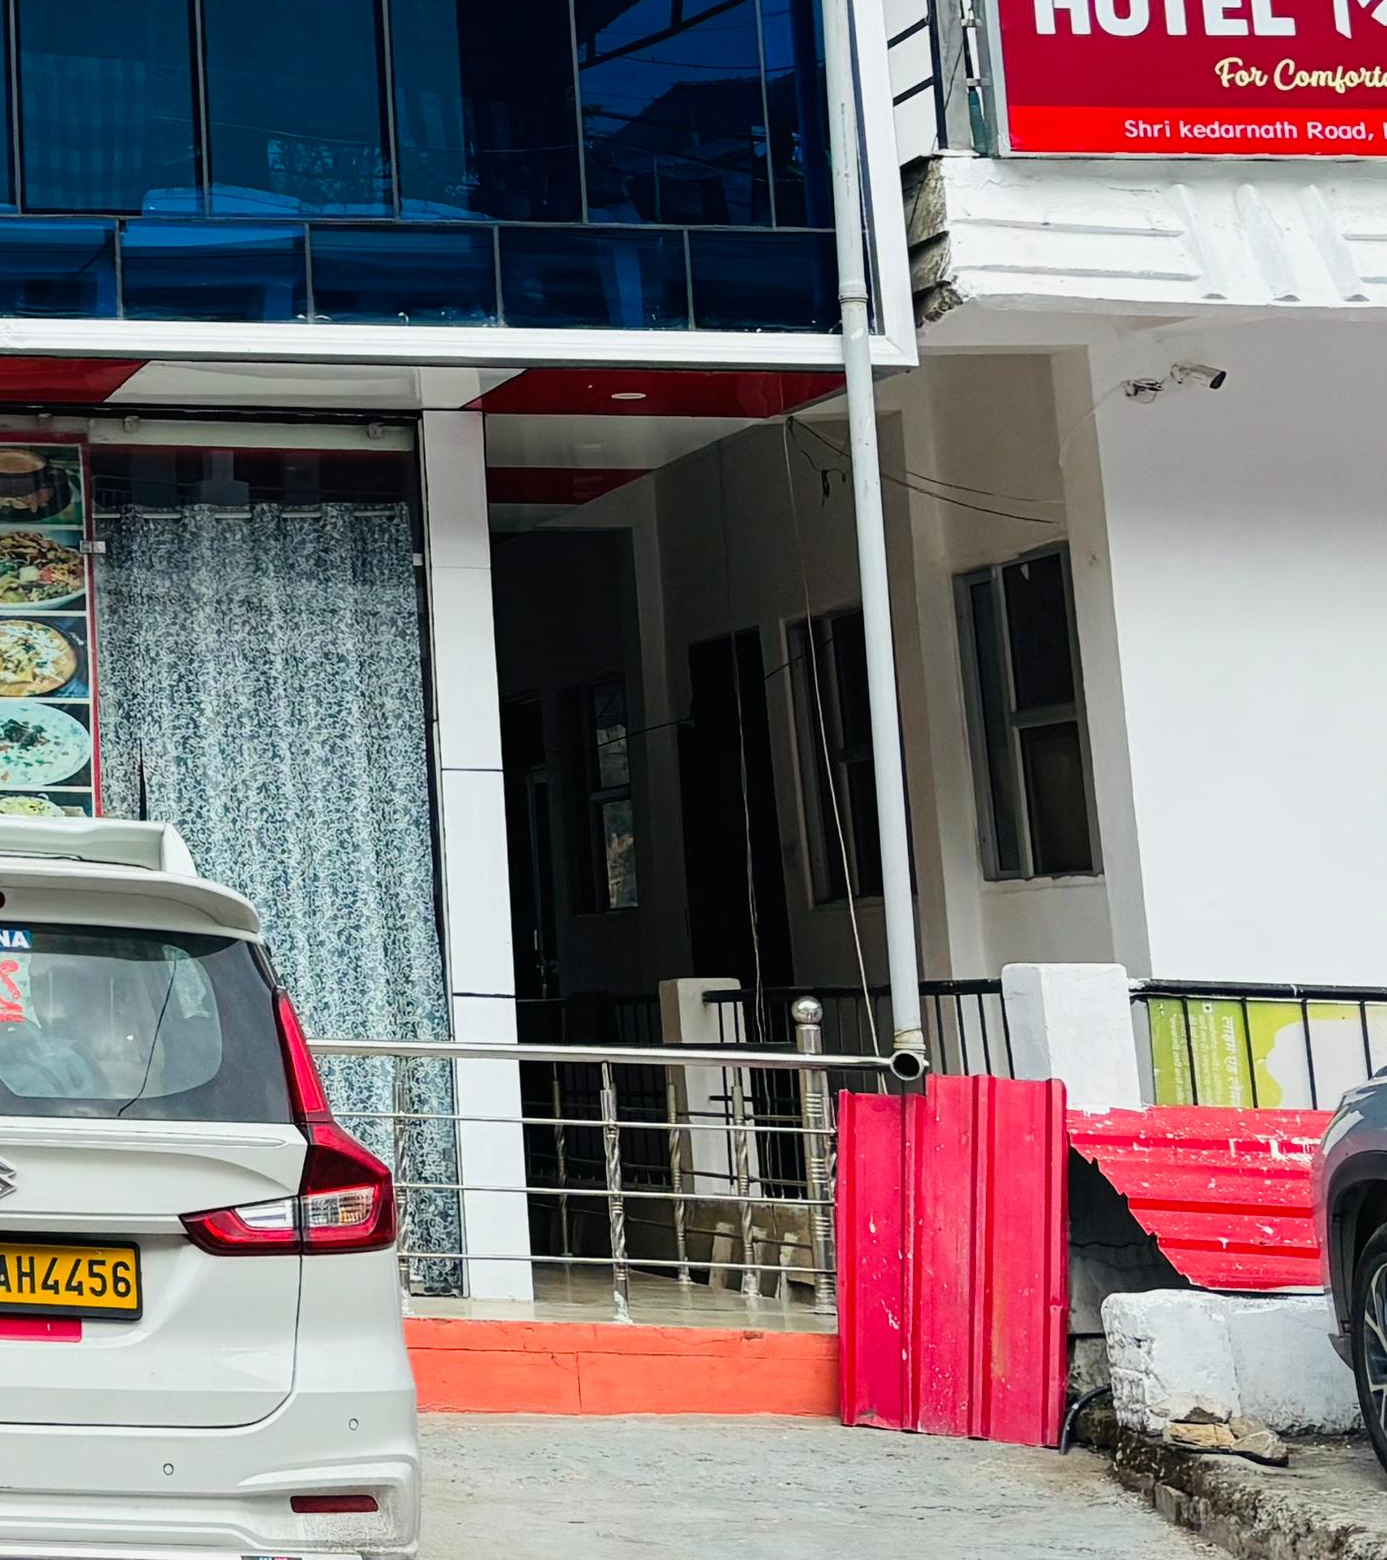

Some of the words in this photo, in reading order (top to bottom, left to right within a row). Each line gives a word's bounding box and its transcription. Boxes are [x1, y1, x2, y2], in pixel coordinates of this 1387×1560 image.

[1213, 56, 1269, 88] For
[1123, 118, 1172, 140] Shri
[1178, 119, 1298, 141] kedarnath
[1306, 121, 1375, 142] Road,
